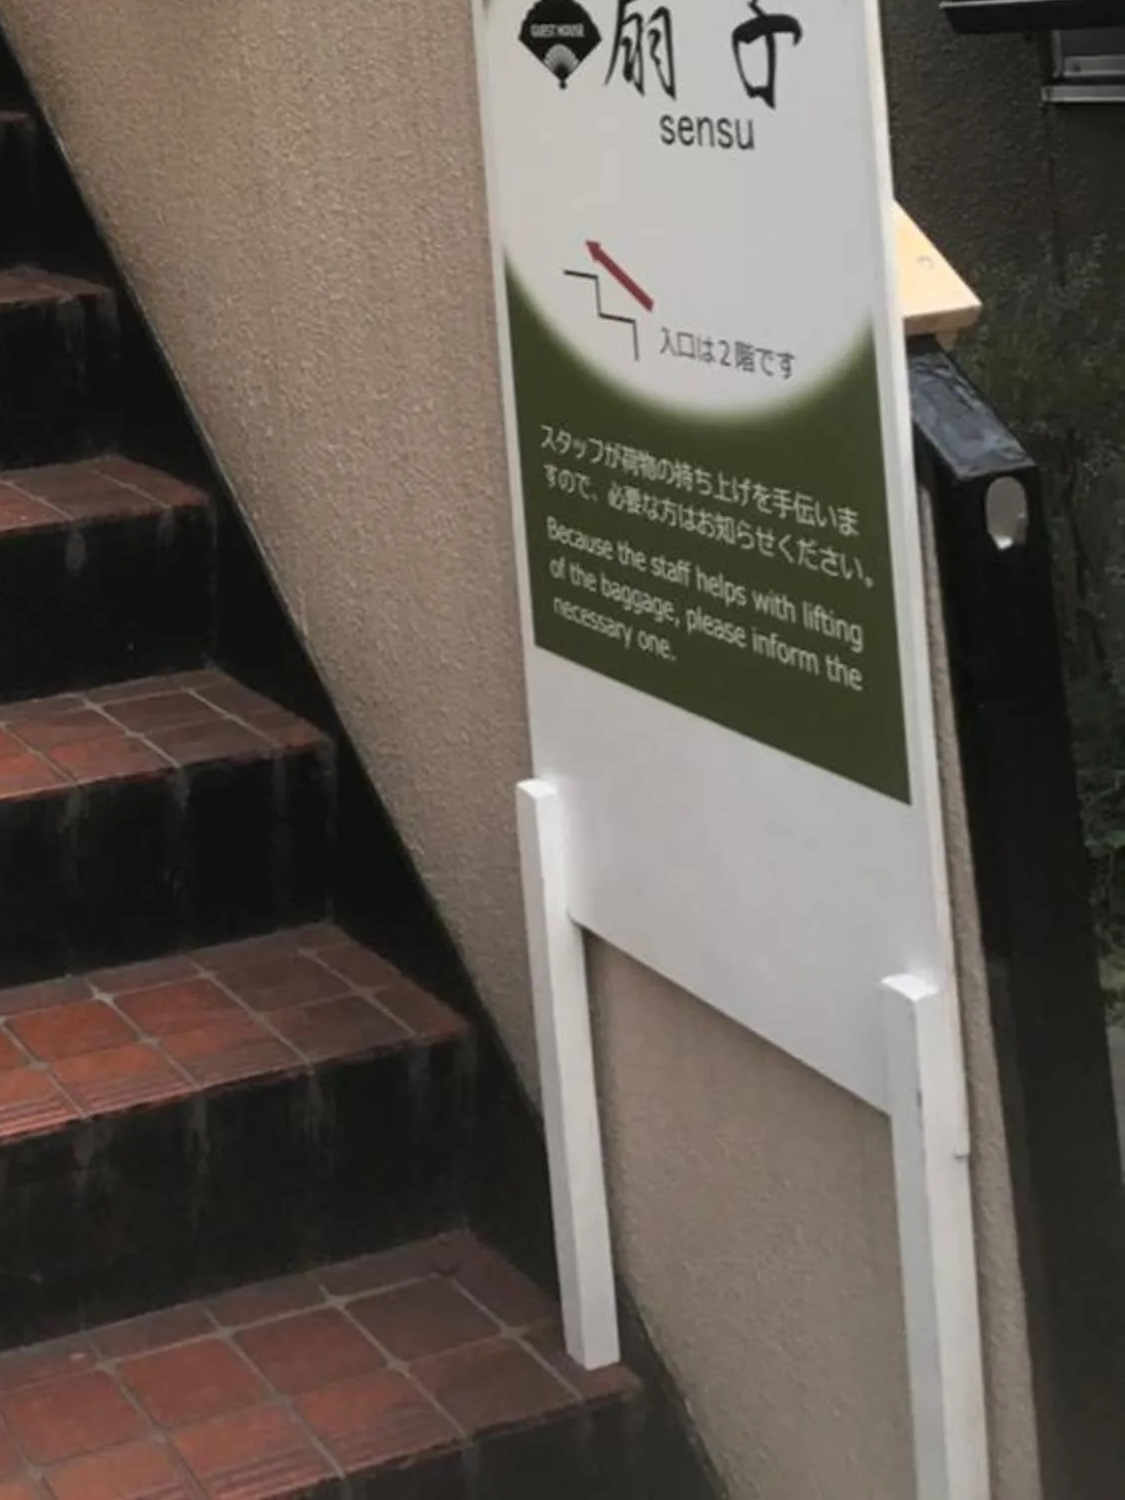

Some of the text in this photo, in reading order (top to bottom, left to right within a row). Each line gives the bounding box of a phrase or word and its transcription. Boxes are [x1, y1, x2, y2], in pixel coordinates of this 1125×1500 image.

[659, 114, 756, 150] sensu
[659, 326, 795, 379] 入口は2階です
[540, 424, 860, 536] スタッフが荷物の持ち上げを手伝いま
[546, 515, 864, 653] Because the staff helps with lifting
[549, 556, 864, 691] of the baggage, please inform the
[553, 596, 677, 661] necessary one.
